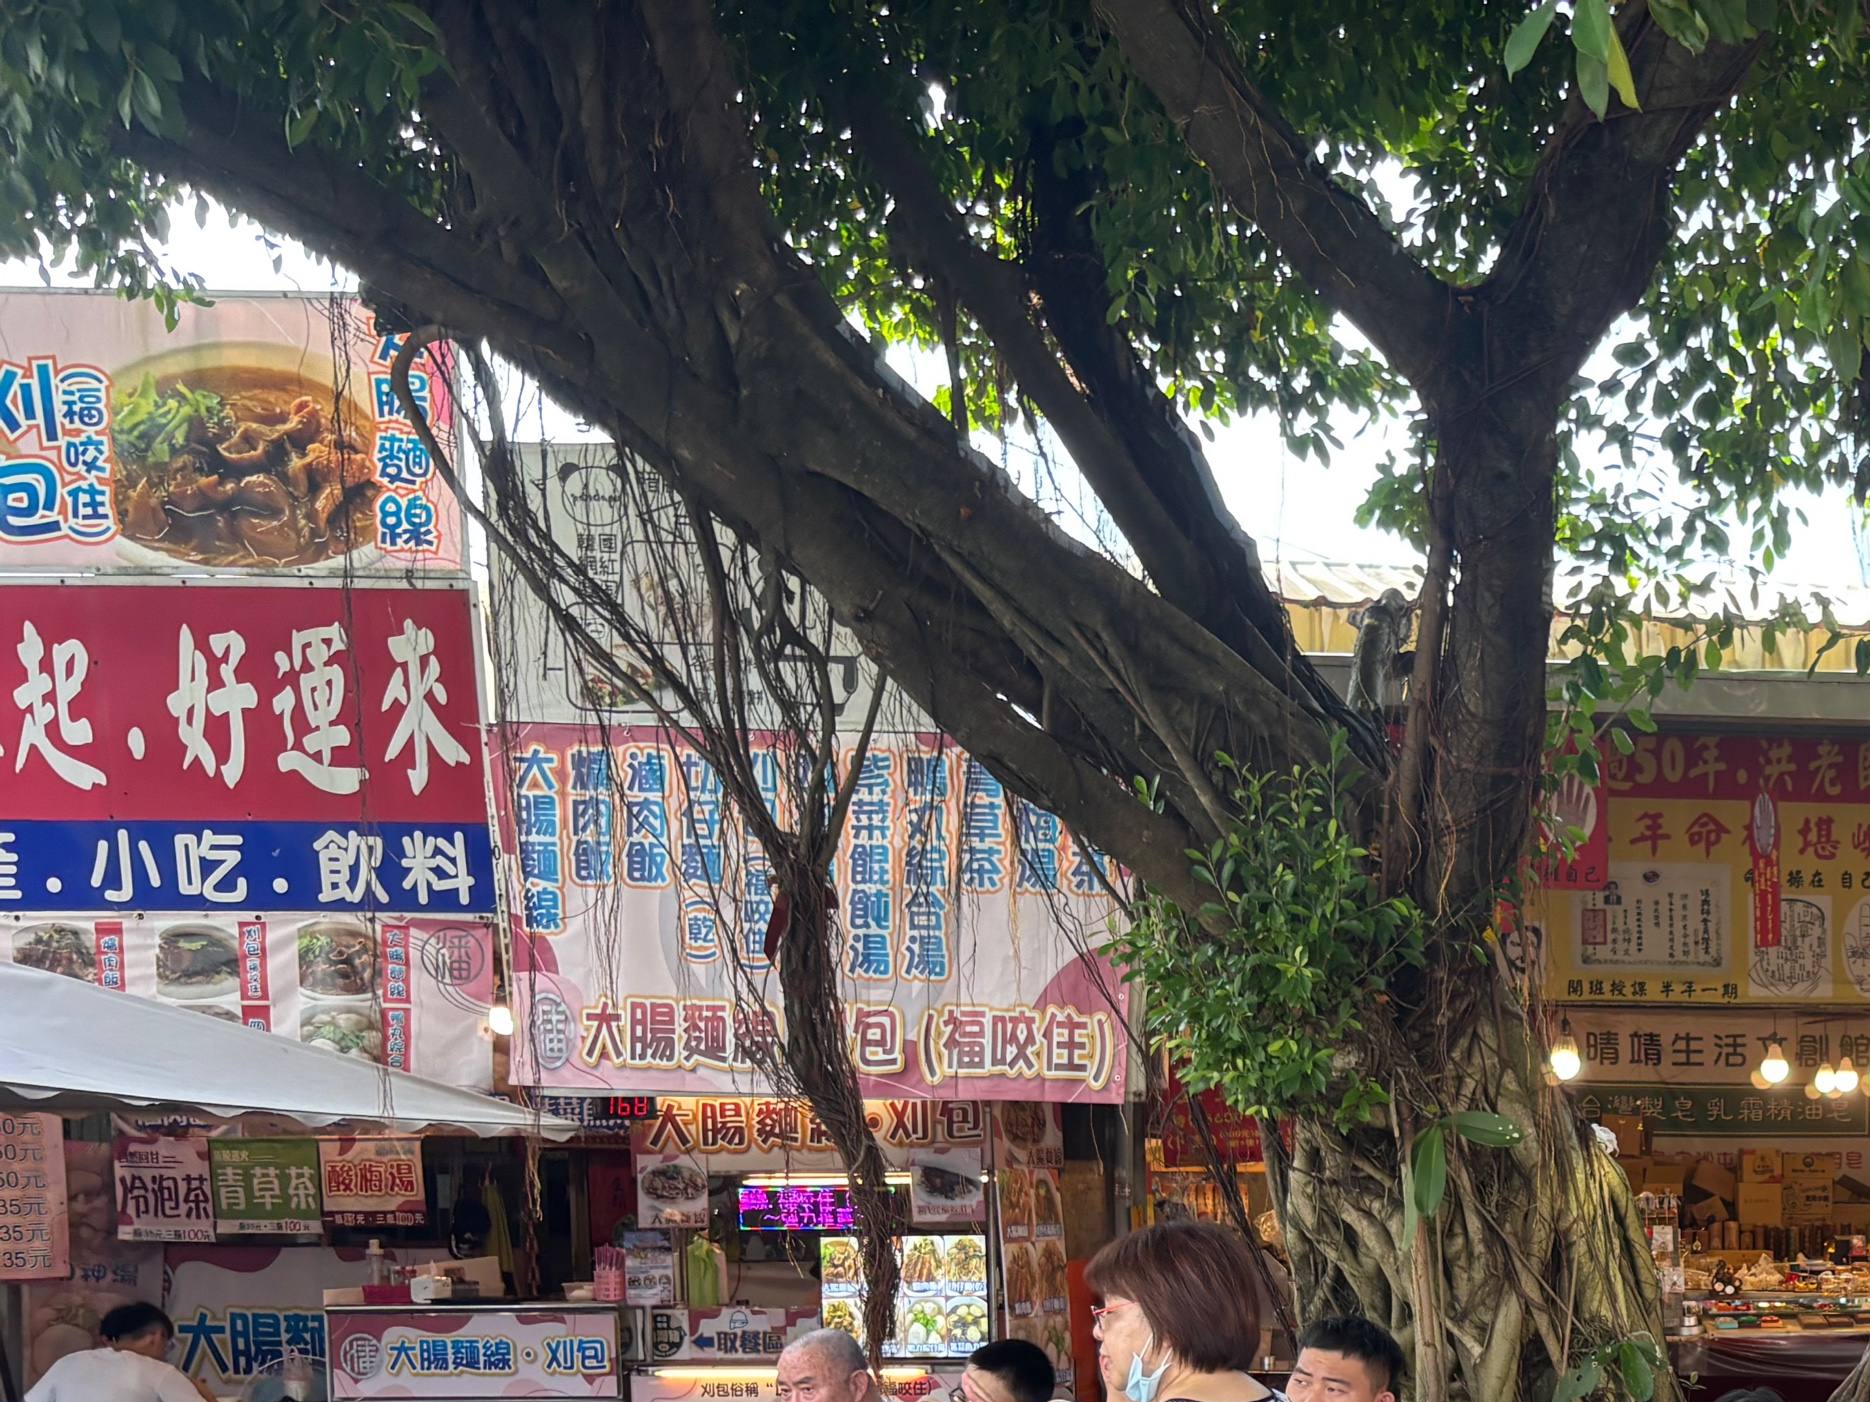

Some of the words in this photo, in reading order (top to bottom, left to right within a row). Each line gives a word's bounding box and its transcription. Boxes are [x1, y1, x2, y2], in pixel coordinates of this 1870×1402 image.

[624, 751, 669, 885] 滷肉飯
[513, 748, 562, 931] 大腸麵線
[1567, 978, 1648, 998] 開班授課
[1660, 980, 1739, 1000] 半年一期
[1706, 1096, 1853, 1123] 乳霜精油皂
[0, 1117, 41, 1137] 0元
[216, 1165, 317, 1211] 青草茶
[326, 1160, 418, 1196] 酸梅湯
[118, 1173, 211, 1219] 冷泡茶
[3, 1250, 52, 1269] 35元
[716, 1330, 784, 1356] 取餐區
